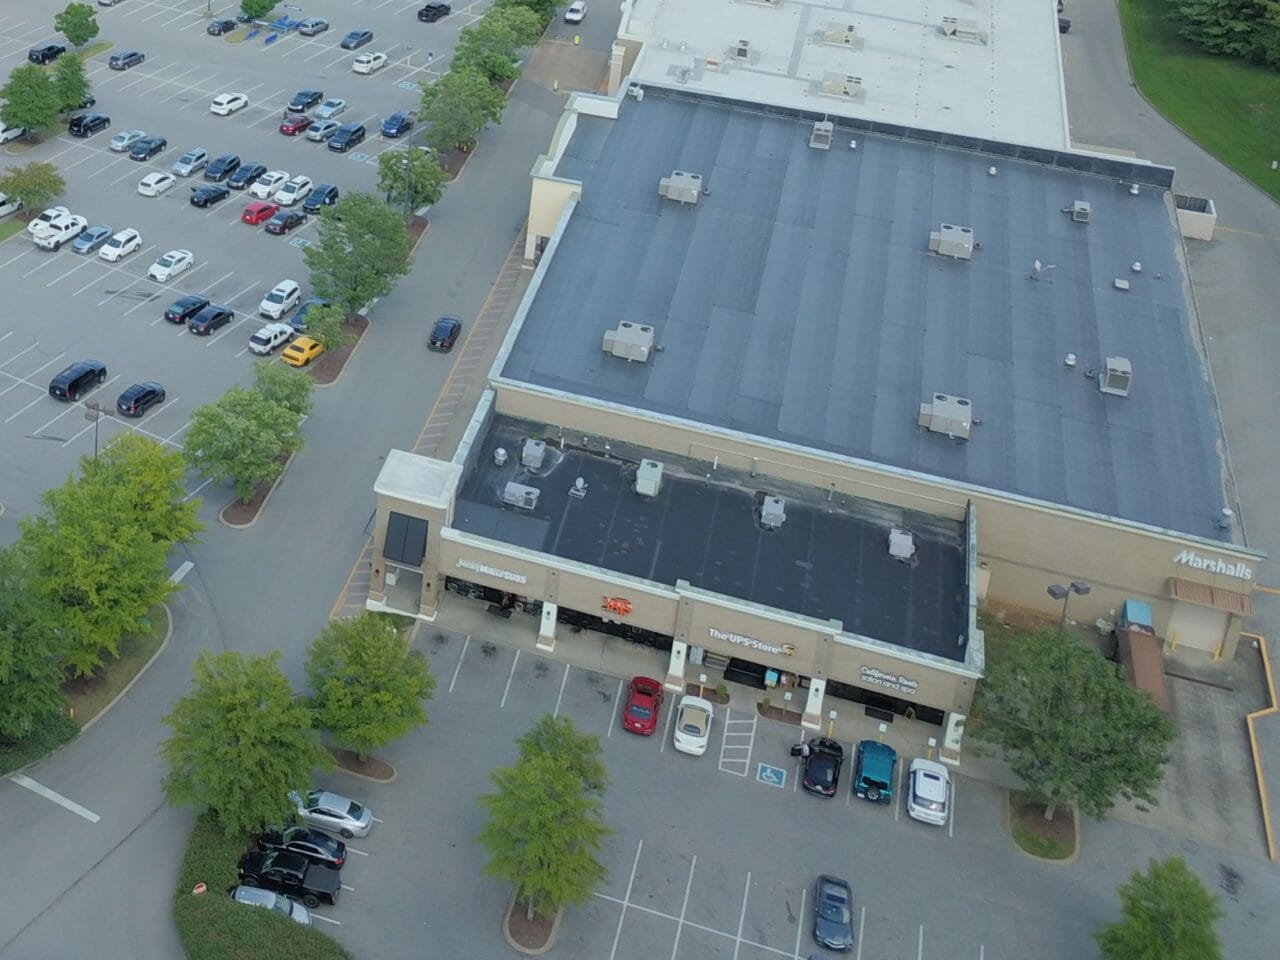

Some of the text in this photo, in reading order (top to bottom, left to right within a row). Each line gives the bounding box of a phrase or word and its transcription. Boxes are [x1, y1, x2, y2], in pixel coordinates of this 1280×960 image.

[1172, 550, 1252, 580] Marshalls
[708, 628, 779, 654] The UPS Store
[861, 675, 916, 694] salon and spa
